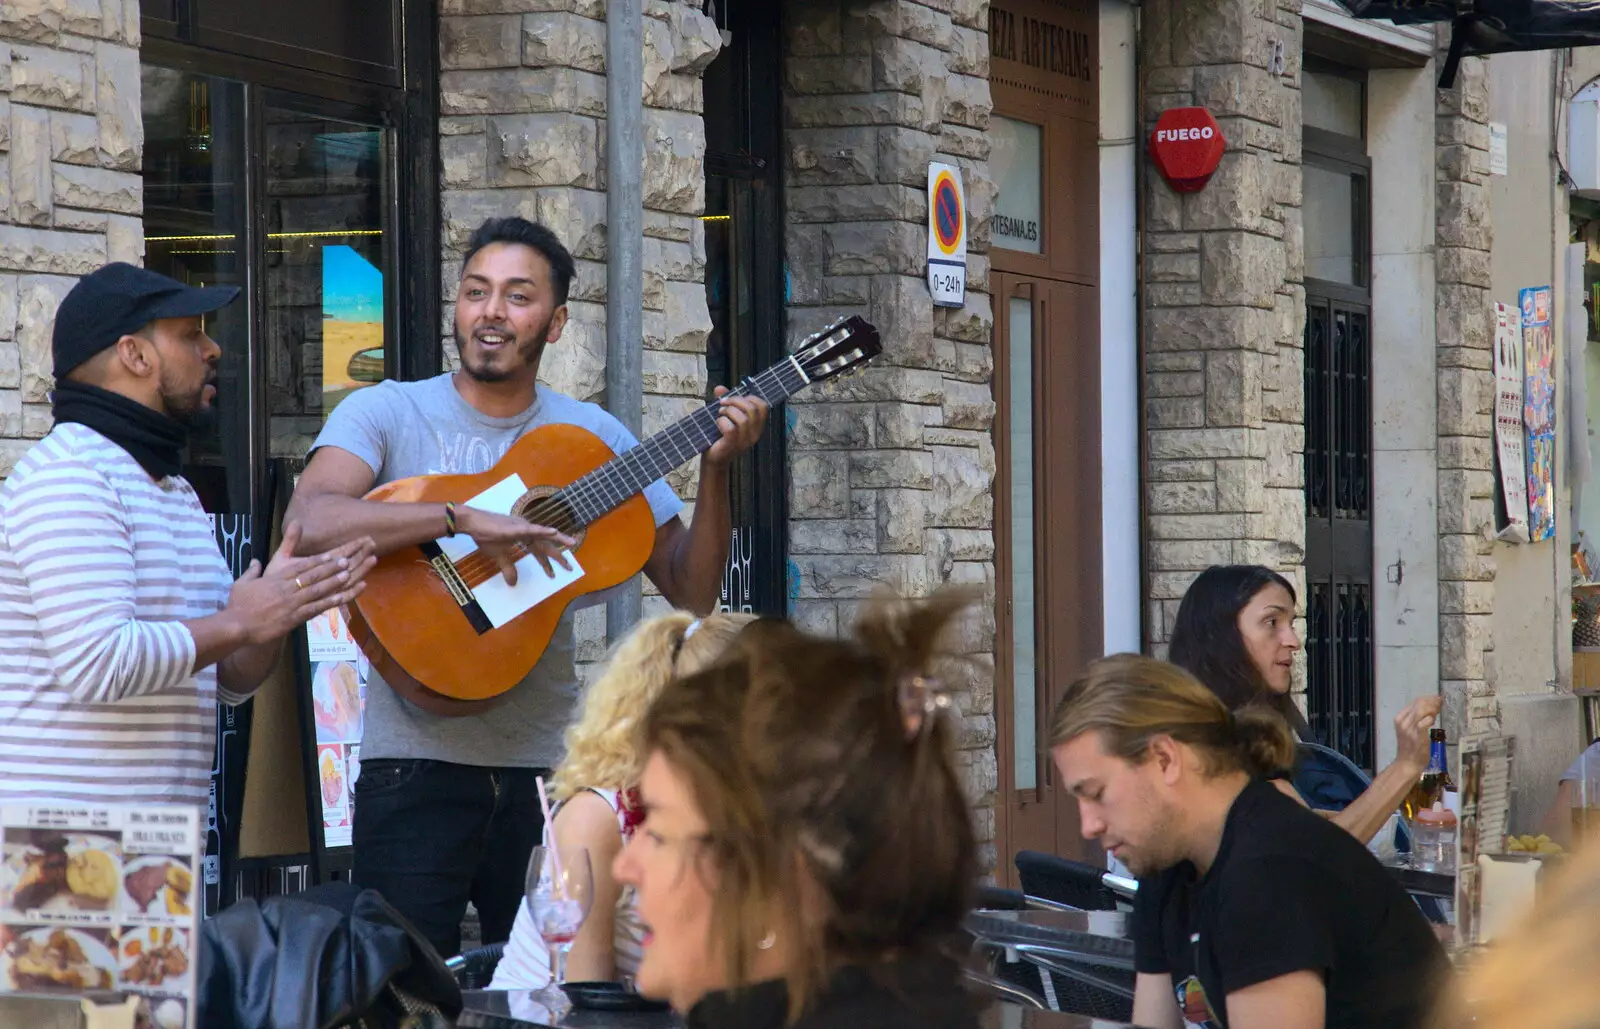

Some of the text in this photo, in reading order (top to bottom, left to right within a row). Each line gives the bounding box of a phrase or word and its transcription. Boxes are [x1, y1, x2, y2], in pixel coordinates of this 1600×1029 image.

[989, 6, 1090, 81] EZA ARTESANA
[1157, 126, 1213, 143] FUEGO
[933, 274, 961, 294] 0-24h
